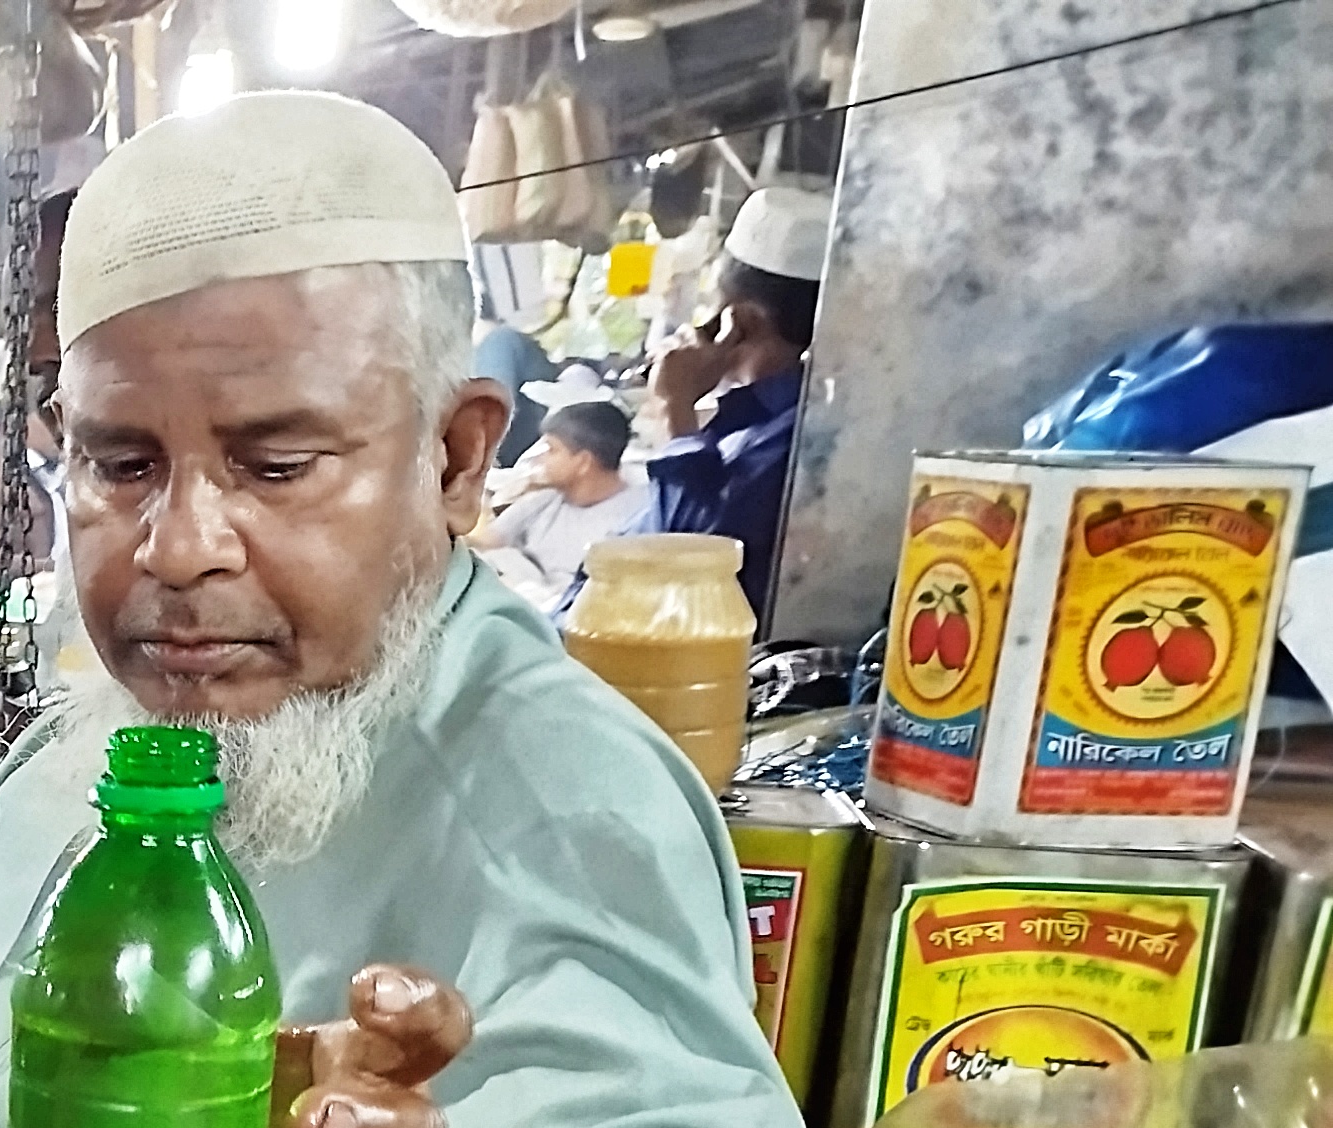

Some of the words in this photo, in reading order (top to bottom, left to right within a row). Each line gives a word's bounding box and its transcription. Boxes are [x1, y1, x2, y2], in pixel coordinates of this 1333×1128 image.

[1047, 731, 1163, 762] নারিকেল
[1173, 733, 1232, 763] তৈল
[928, 920, 1007, 950] গরুর
[1021, 911, 1093, 947] গাড়ী
[1105, 924, 1181, 962] মার্কা
